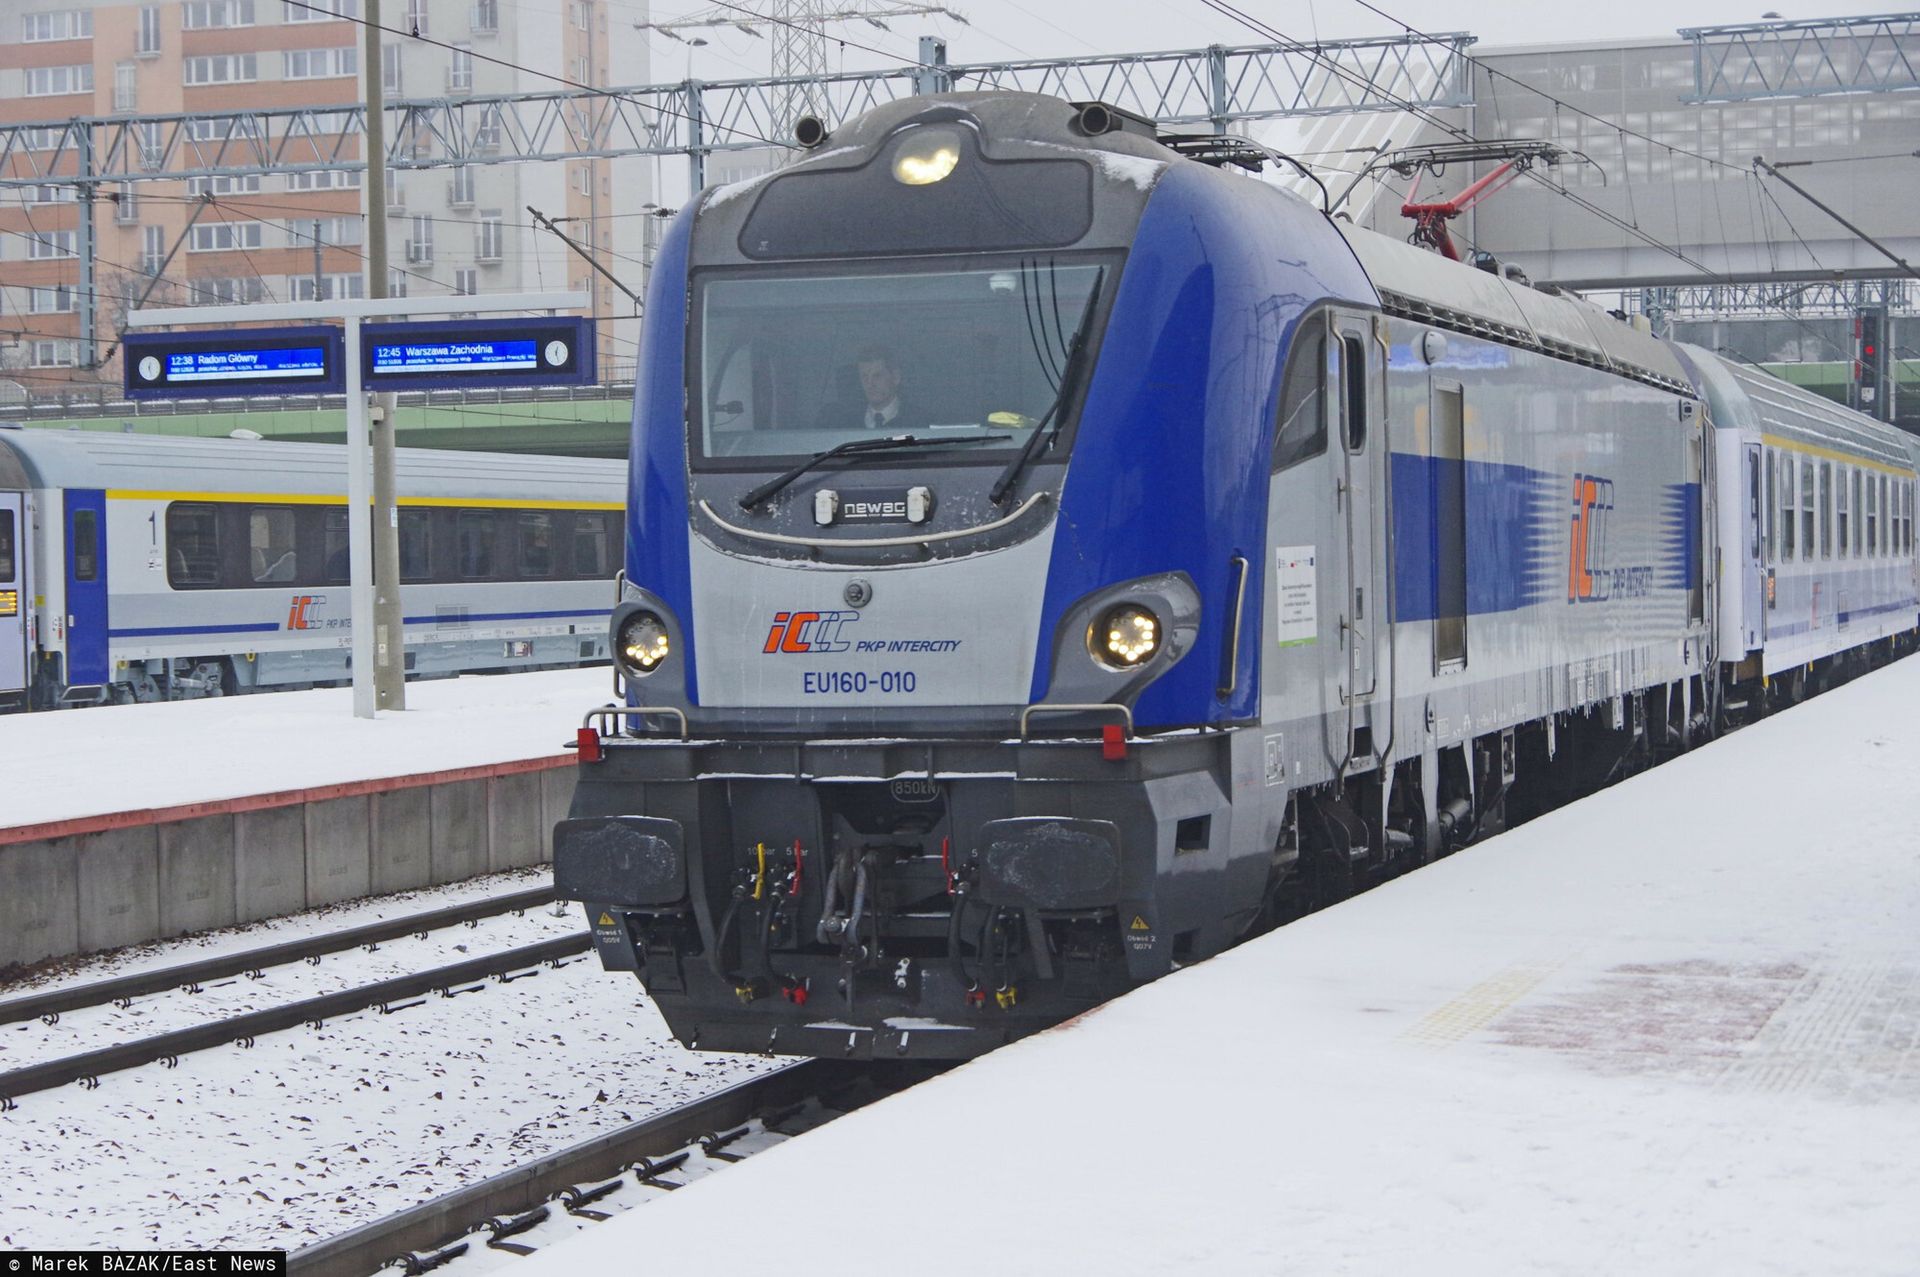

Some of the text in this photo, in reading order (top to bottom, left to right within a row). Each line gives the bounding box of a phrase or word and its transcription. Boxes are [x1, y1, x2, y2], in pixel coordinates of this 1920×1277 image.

[378, 344, 494, 358] 12:45 Warszawa Zachodnia
[171, 352, 258, 366] 12:38 Radom Główny
[148, 510, 156, 546] 1
[855, 639, 962, 652] PKP INTERCITY
[803, 671, 917, 694] EU160-010
[747, 847, 758, 856] 10
[785, 846, 793, 856] 5
[971, 848, 979, 858] 5
